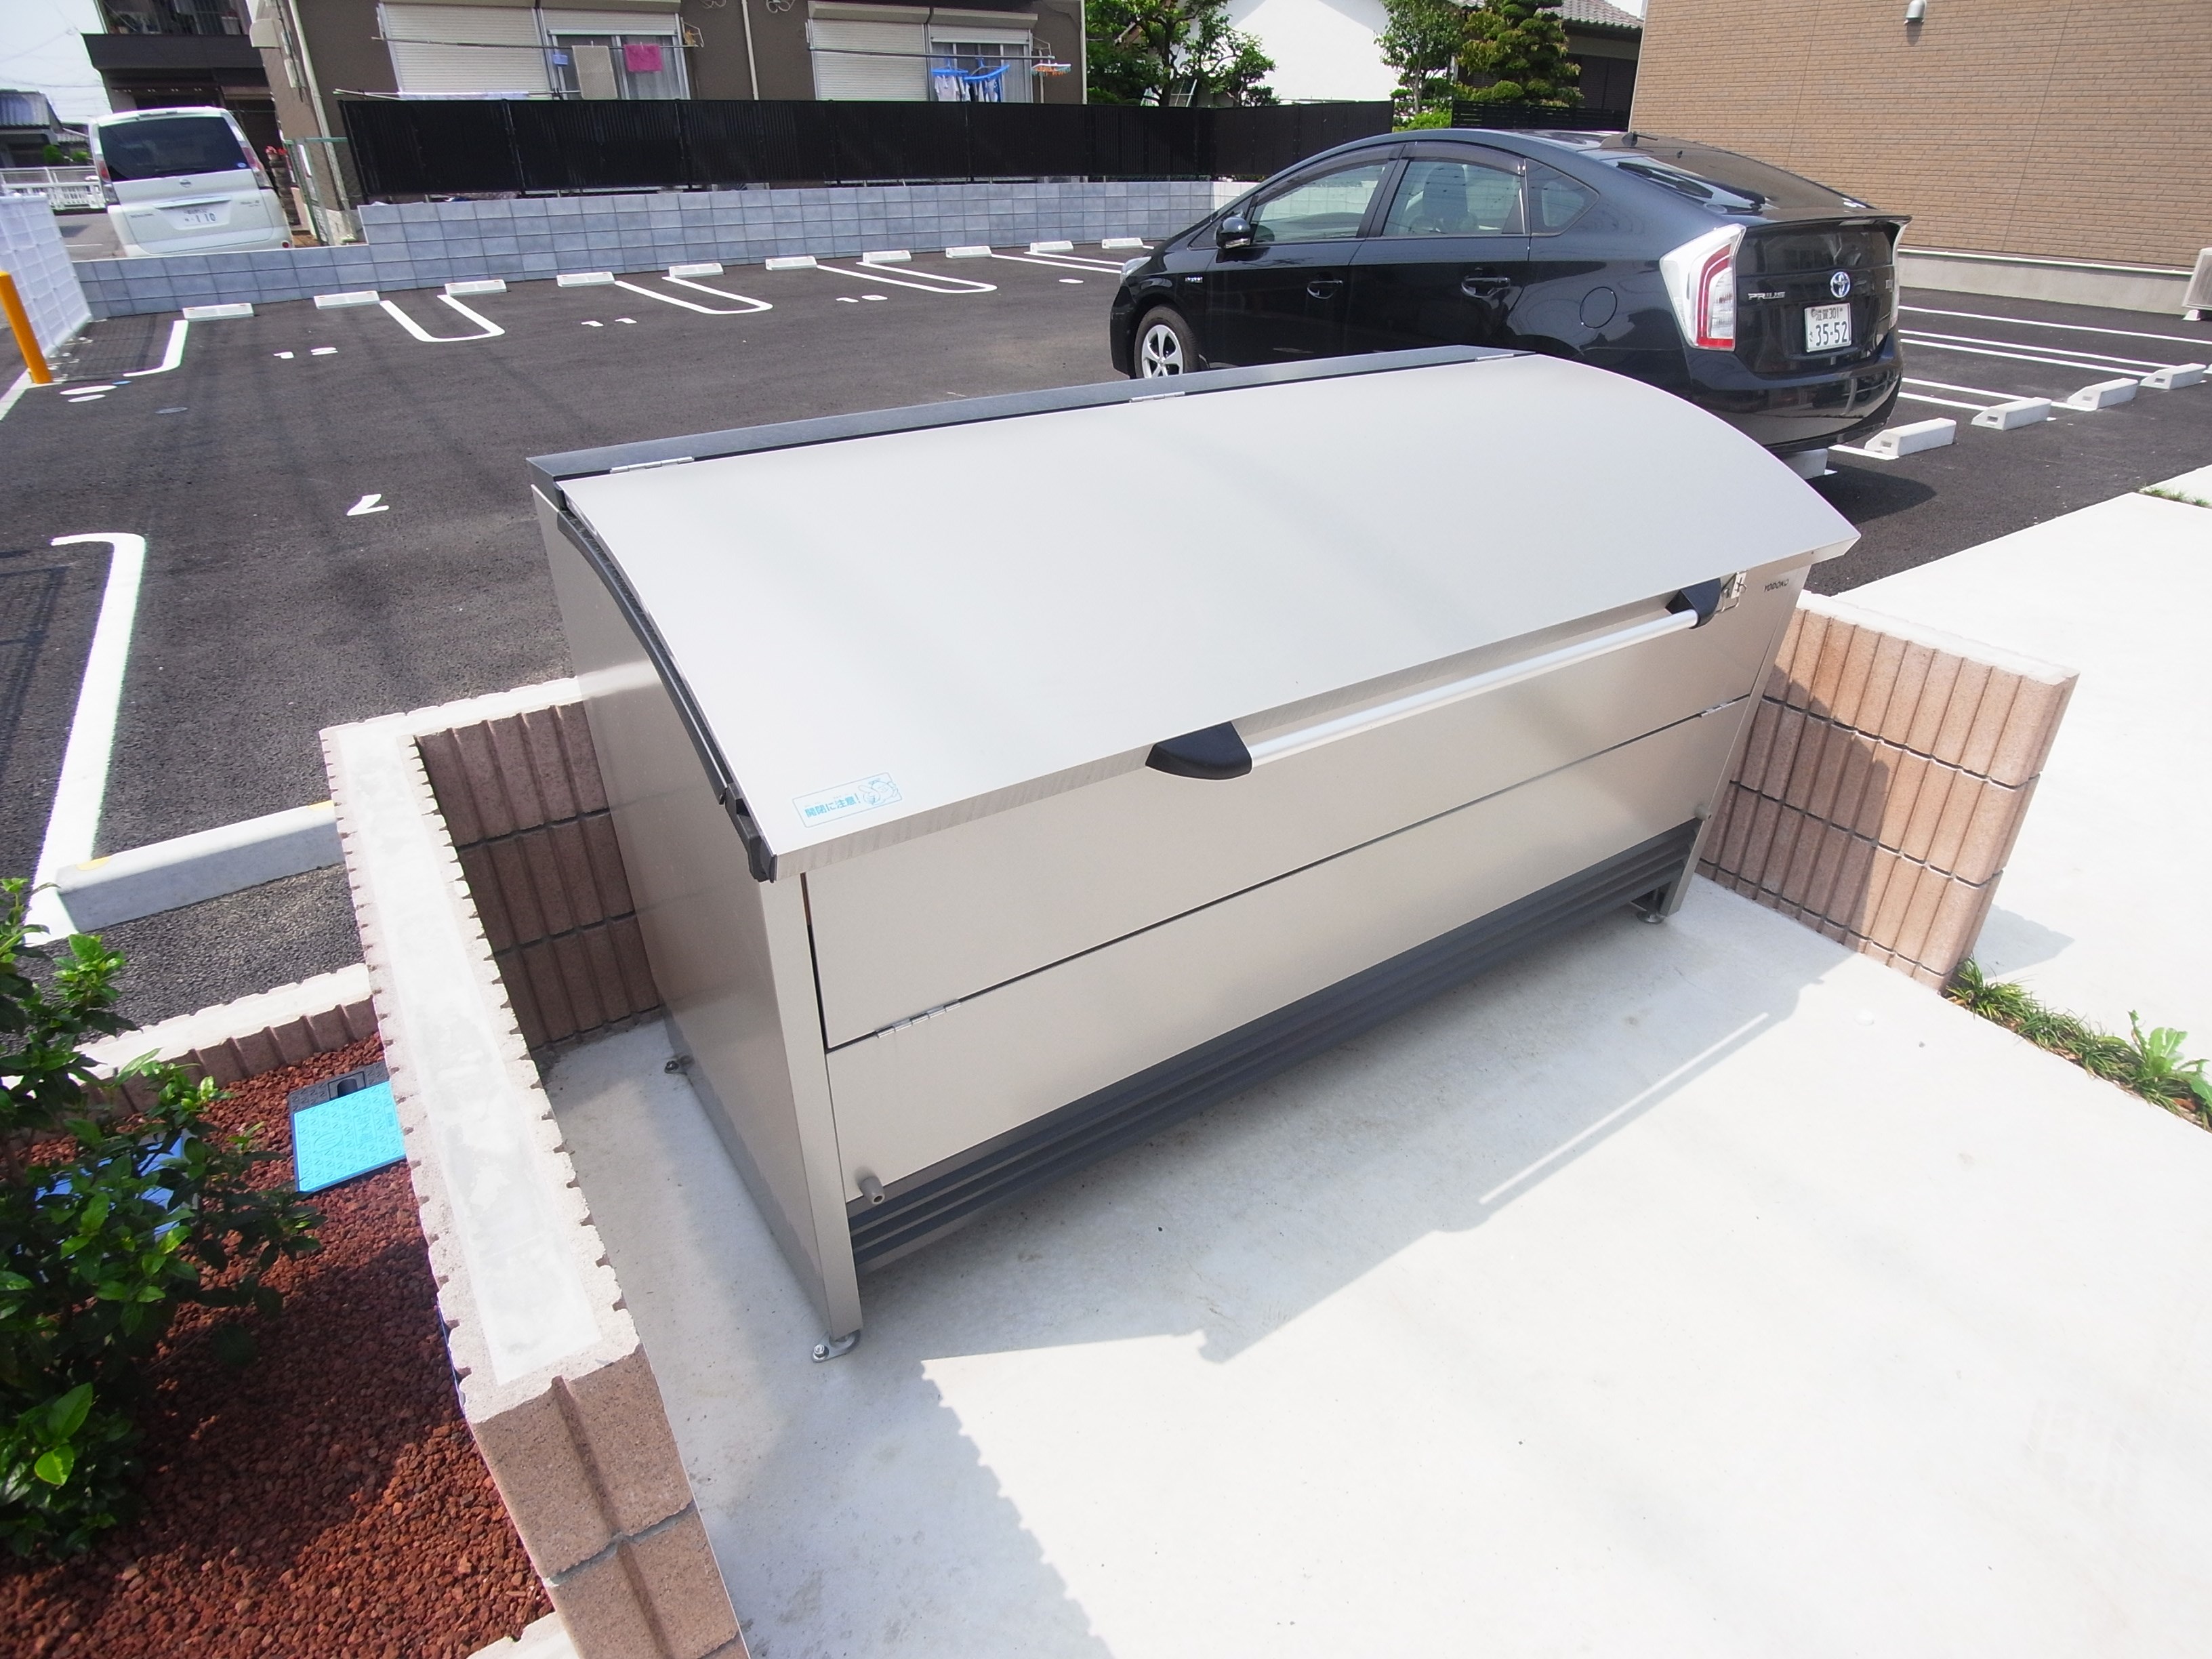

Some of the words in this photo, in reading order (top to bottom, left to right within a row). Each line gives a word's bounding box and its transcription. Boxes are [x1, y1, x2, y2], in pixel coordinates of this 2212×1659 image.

[1748, 291, 1785, 300] PRIUS
[1829, 307, 1839, 319] 301
[1816, 321, 1848, 346] 35-52
[1764, 579, 1789, 592] YODOKO
